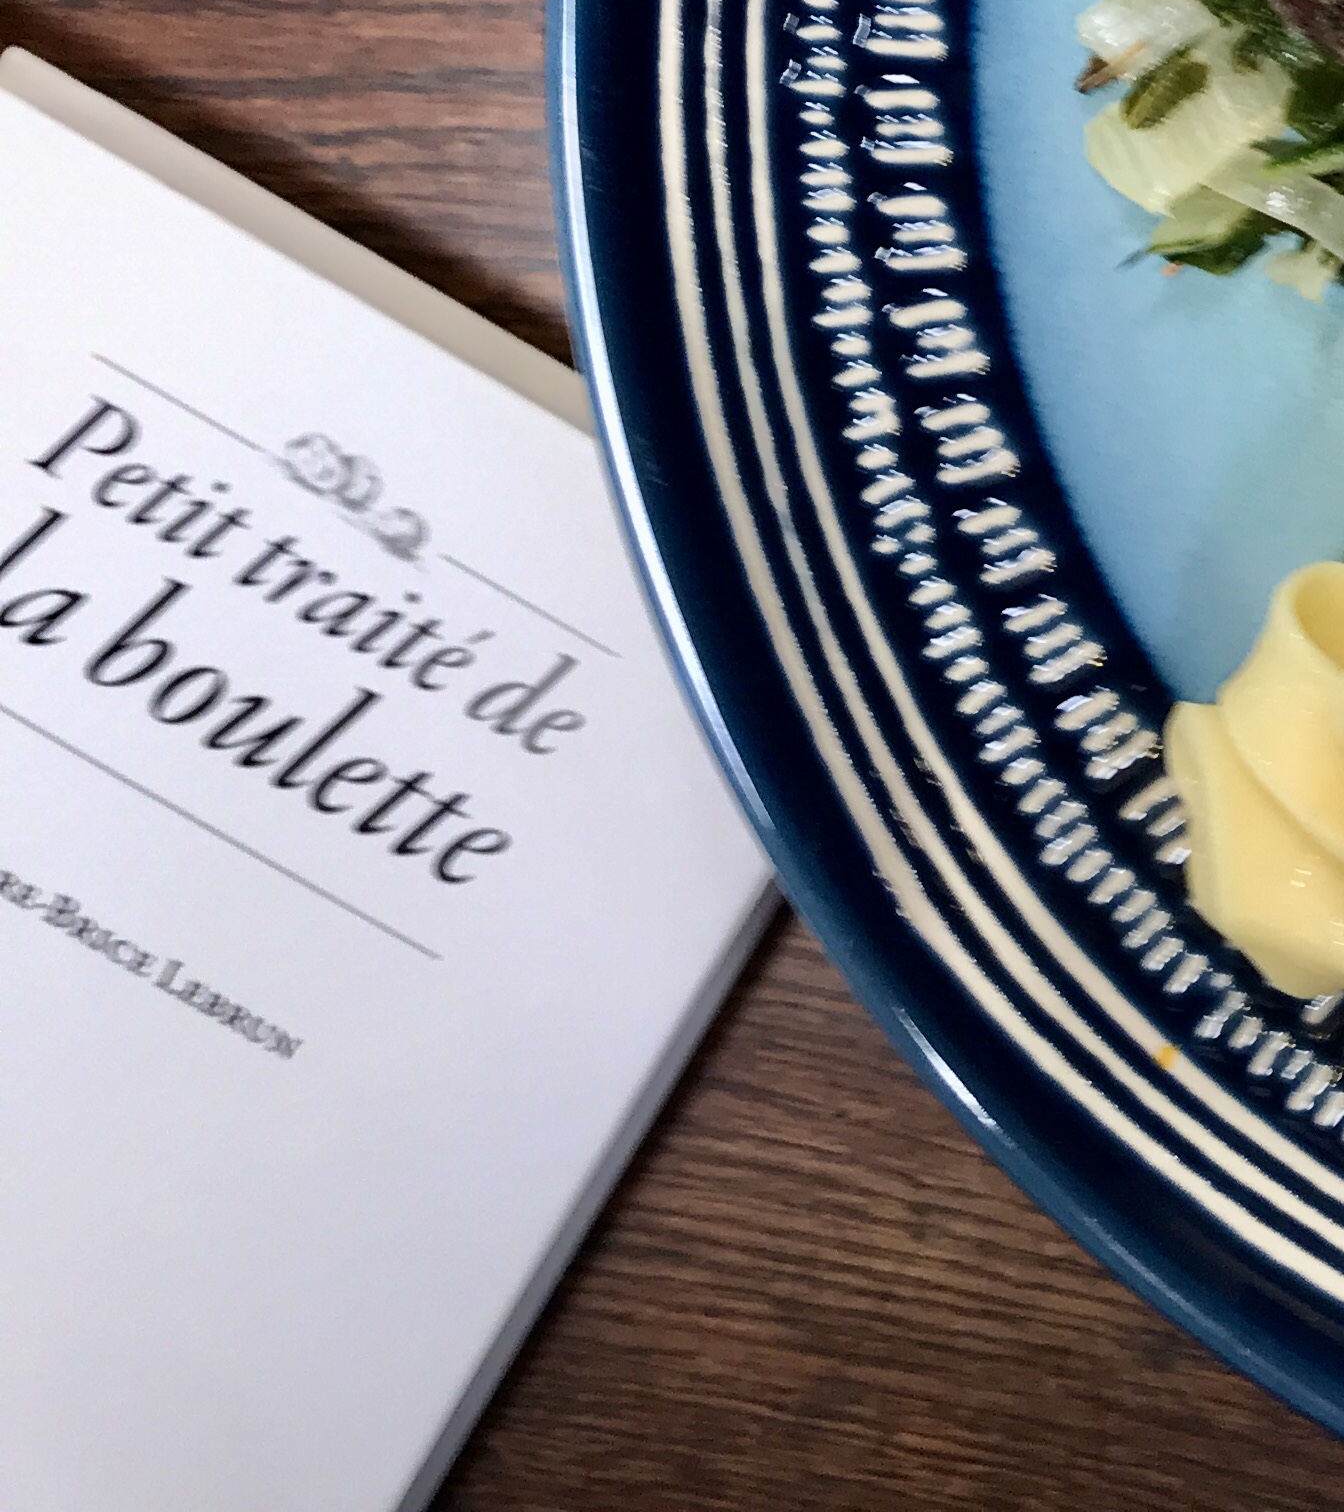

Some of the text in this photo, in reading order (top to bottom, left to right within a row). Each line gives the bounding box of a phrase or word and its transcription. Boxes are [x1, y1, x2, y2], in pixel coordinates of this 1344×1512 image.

[0, 505, 513, 886] la boulette
[25, 393, 587, 756] Petit traité de
